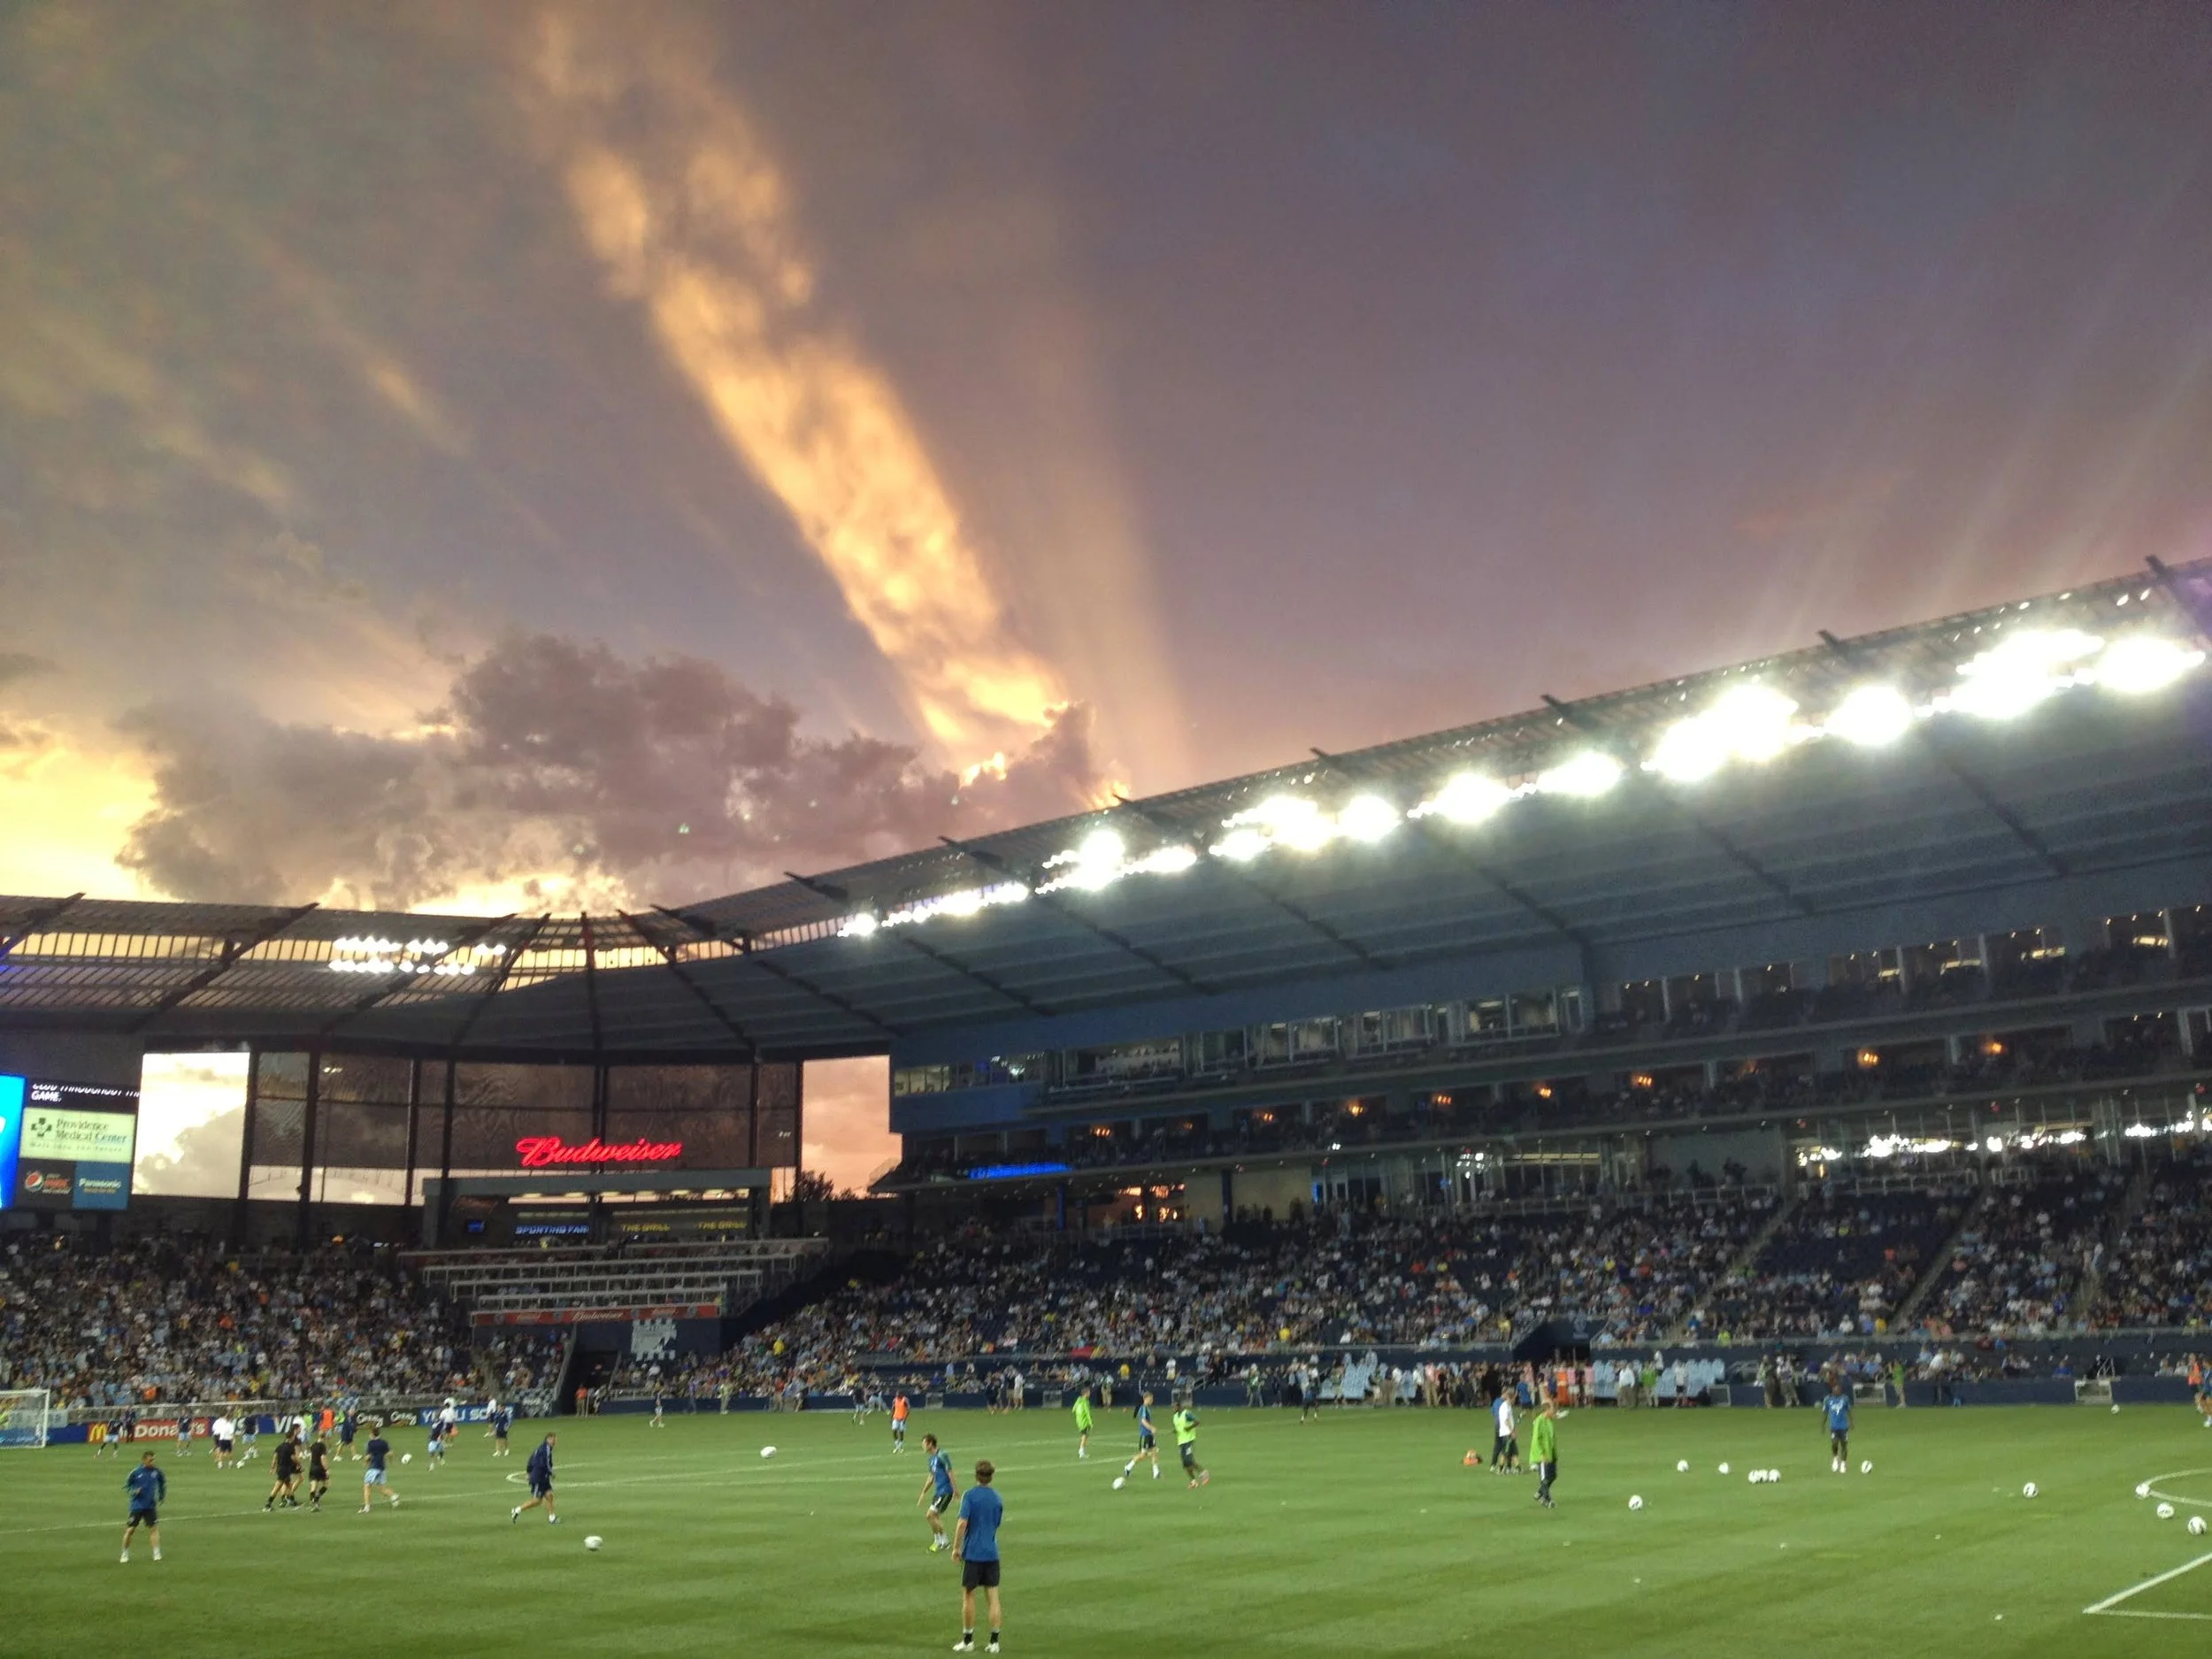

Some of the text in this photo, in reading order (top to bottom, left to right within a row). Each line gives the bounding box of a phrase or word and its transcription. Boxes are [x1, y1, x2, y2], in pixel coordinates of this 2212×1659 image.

[56, 1129, 127, 1144] Medical Center
[516, 1136, 683, 1167] Budweiser
